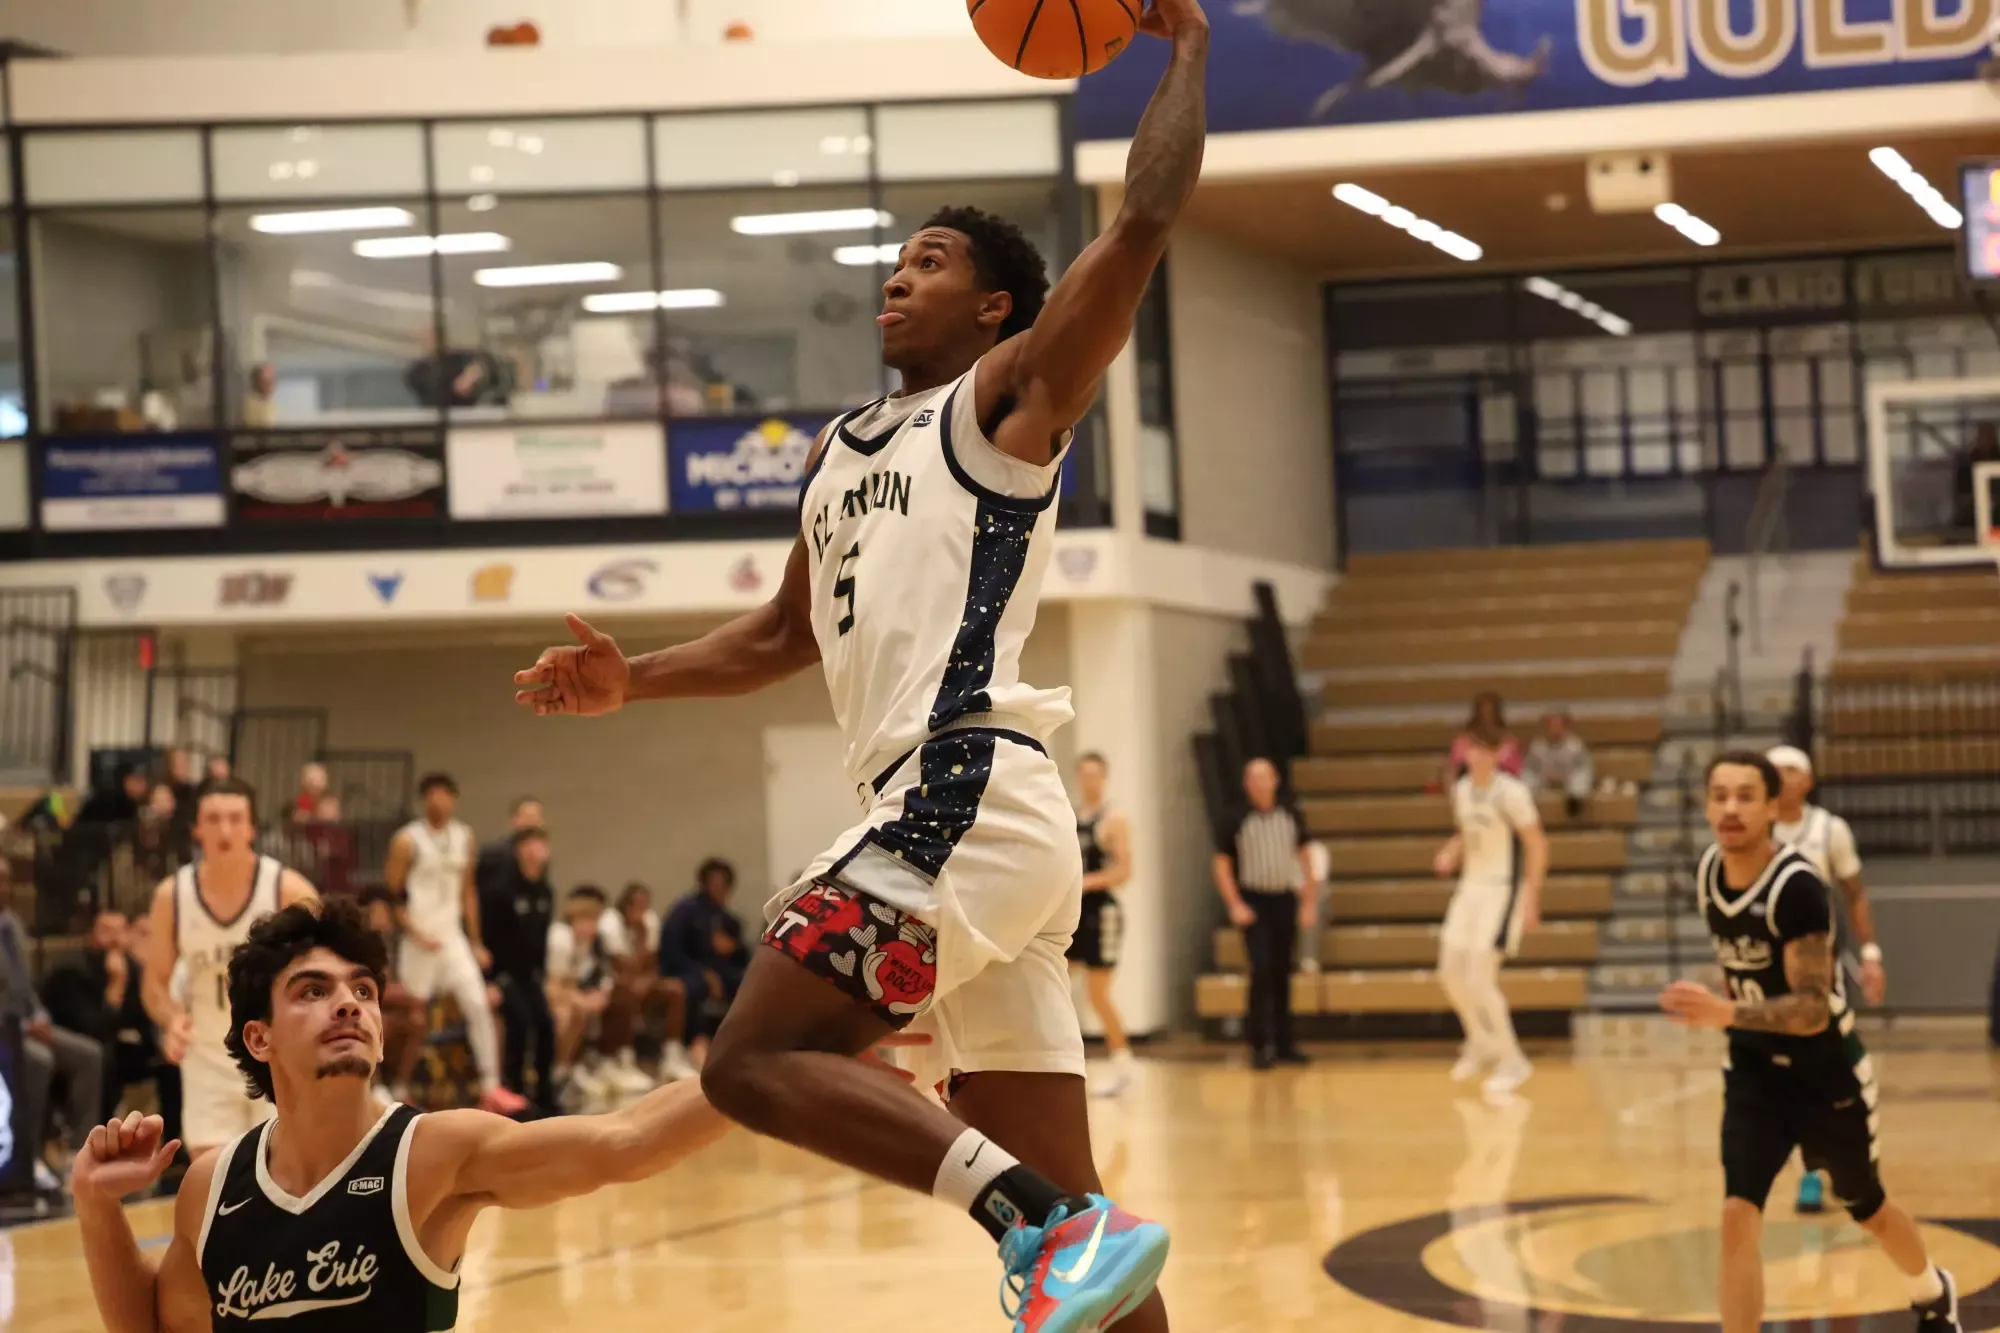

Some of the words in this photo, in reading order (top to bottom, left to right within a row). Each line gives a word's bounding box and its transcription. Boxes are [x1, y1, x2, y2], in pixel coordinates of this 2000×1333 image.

[1577, 0, 1996, 87] GOLD
[833, 541, 860, 637] 5
[217, 1262, 297, 1318] Lake
[307, 1240, 379, 1292] Erie
